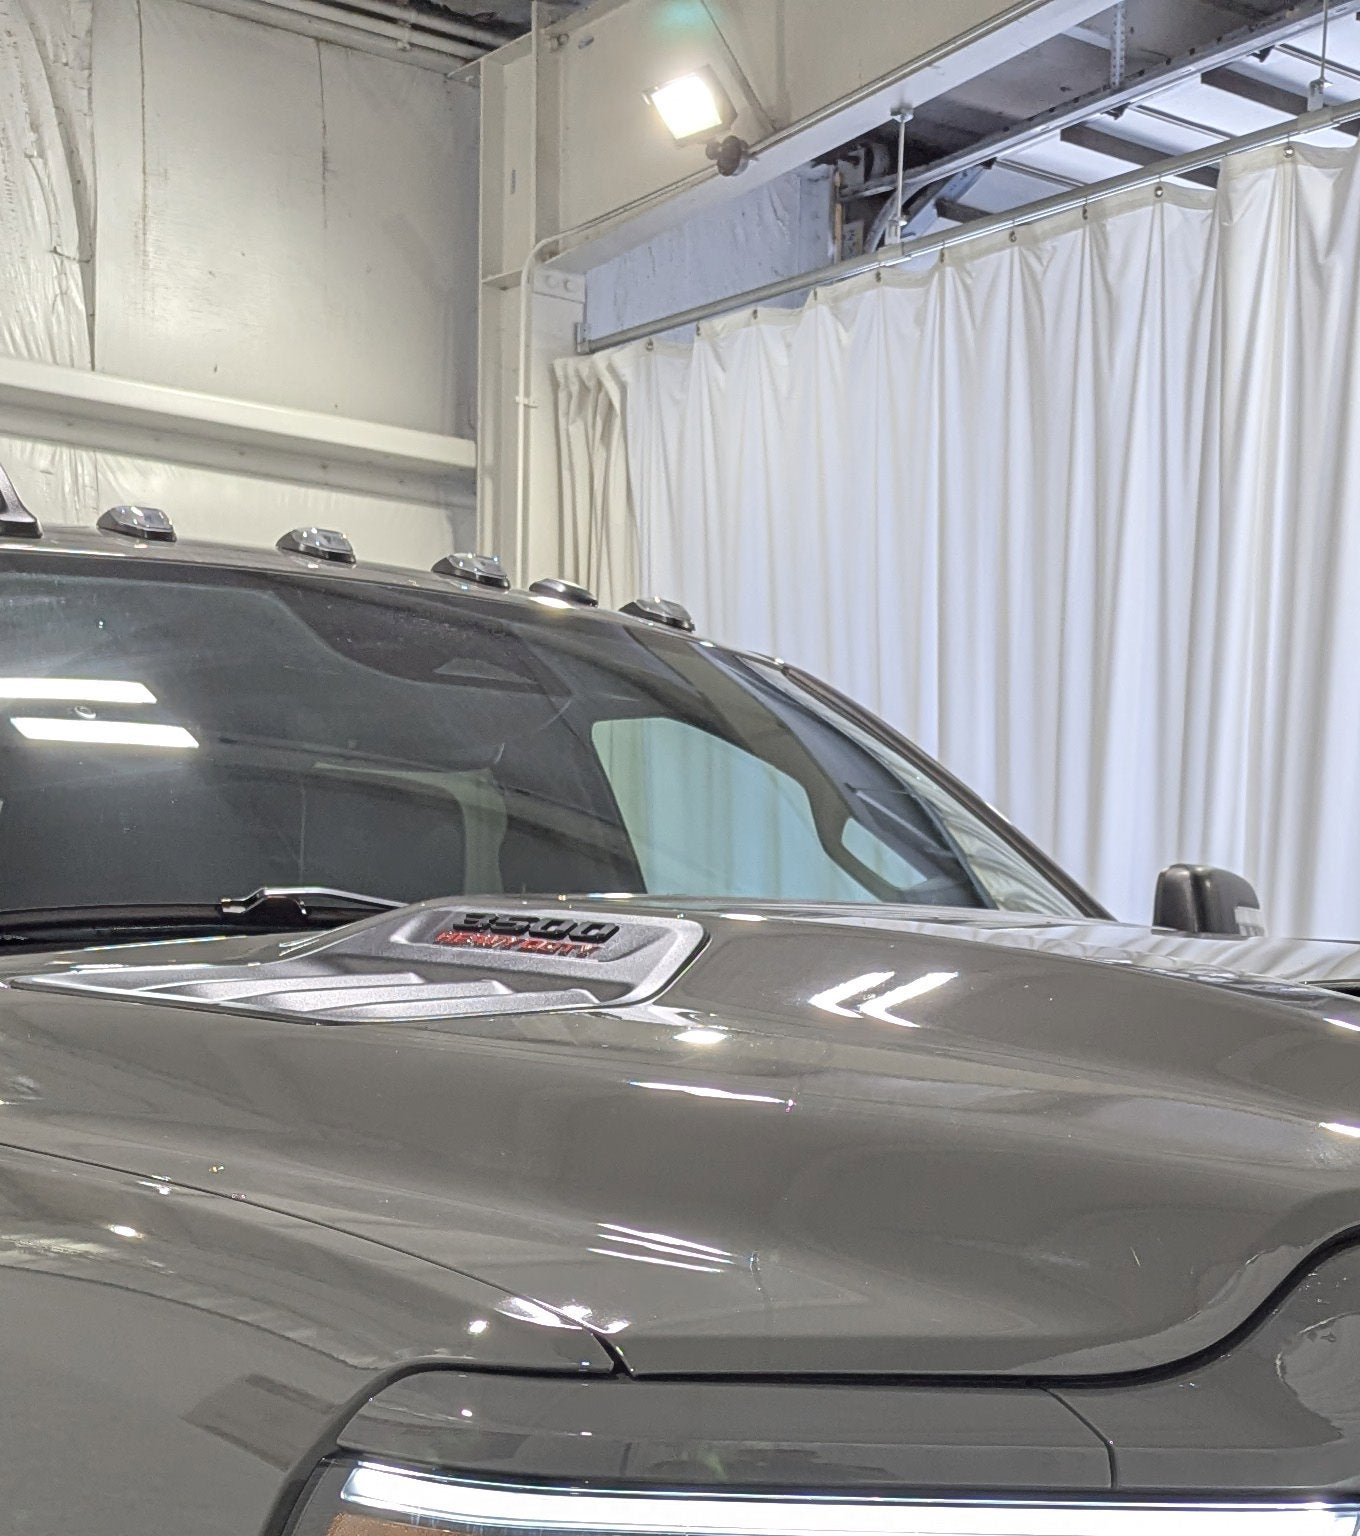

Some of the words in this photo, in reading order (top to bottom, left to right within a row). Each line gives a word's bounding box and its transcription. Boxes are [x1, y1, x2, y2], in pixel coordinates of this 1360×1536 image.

[452, 911, 620, 944] 3500
[433, 930, 526, 950] HEAVY
[517, 938, 603, 958] DUTY
